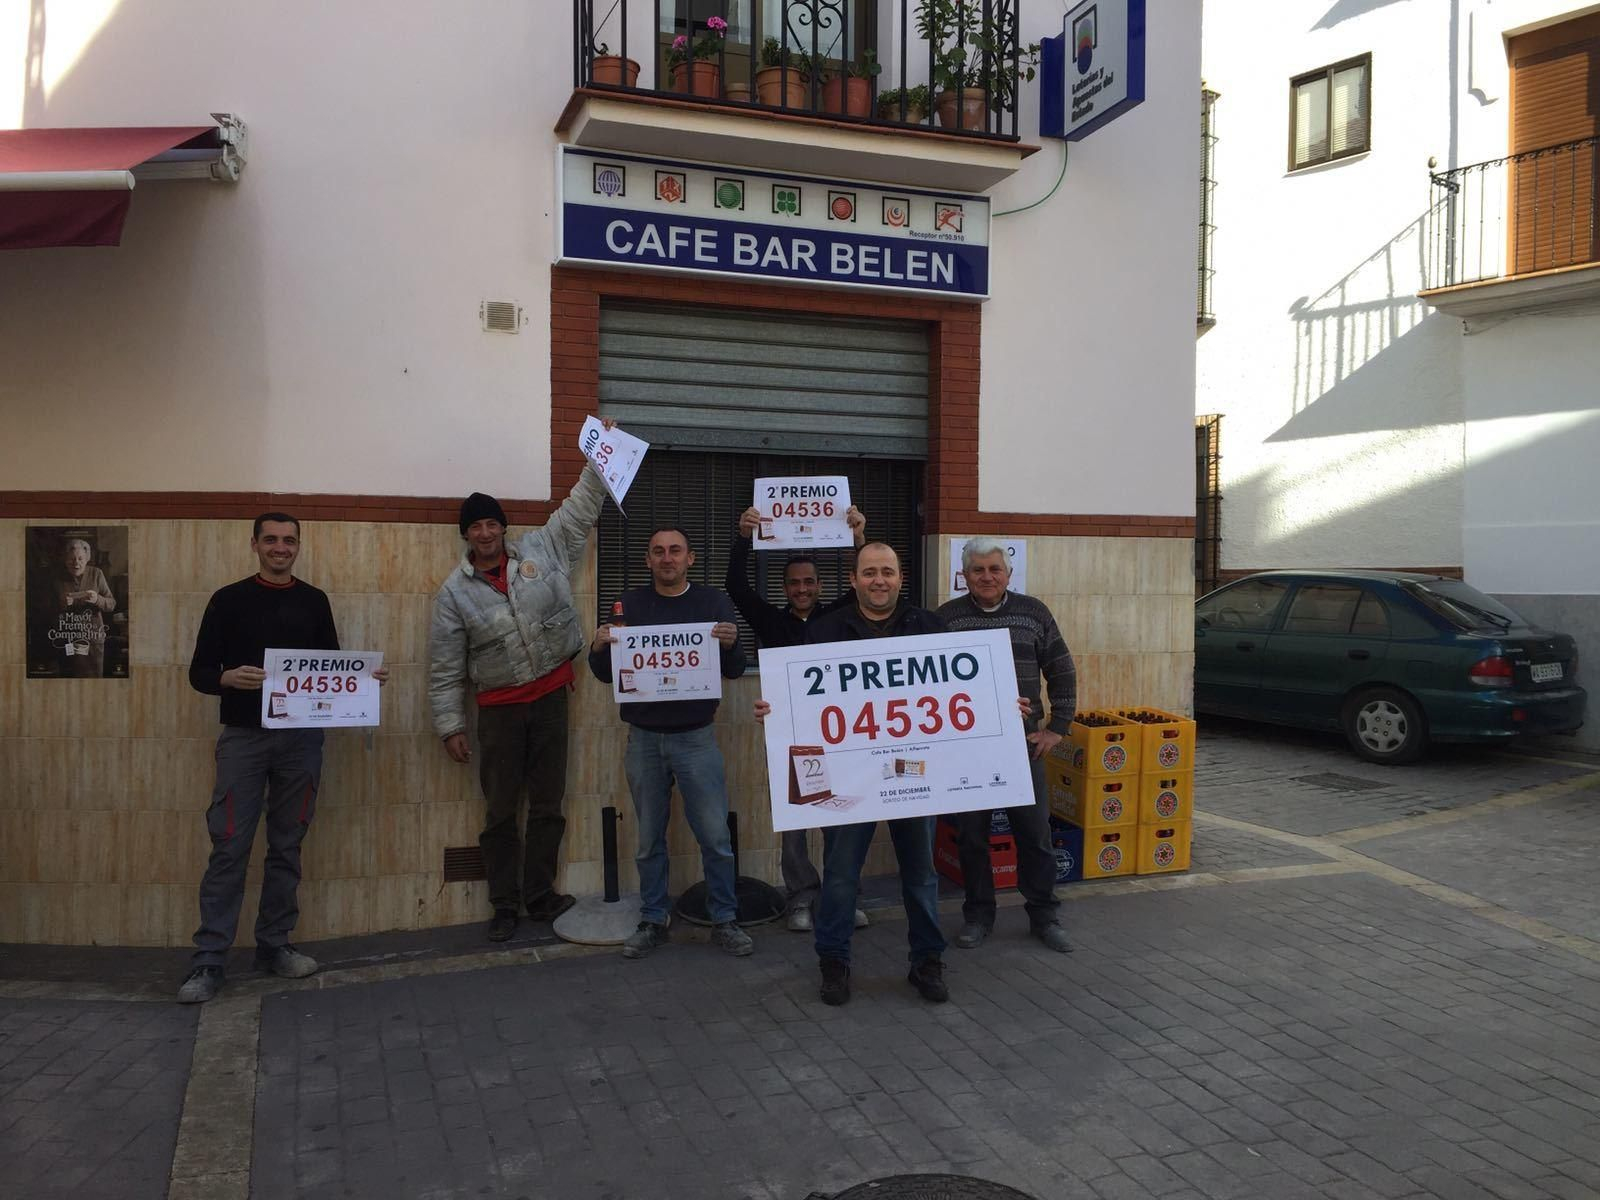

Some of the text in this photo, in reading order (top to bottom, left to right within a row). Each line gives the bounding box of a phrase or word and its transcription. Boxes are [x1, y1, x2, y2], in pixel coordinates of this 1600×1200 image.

[909, 229, 937, 241] Receptor
[605, 219, 955, 284] CAFE BAR BELEN
[781, 485, 838, 498] PREMIO
[772, 501, 834, 518] 04536
[65, 609, 92, 623] Mayor
[59, 619, 93, 632] Premio
[642, 632, 704, 649] PREMIO
[298, 659, 365, 672] PREMIO
[633, 650, 700, 670] 04536
[838, 652, 979, 693] PREMIO
[286, 675, 358, 693] 04536
[820, 692, 976, 745] 04536
[803, 759, 824, 778] 22
[898, 786, 931, 795] DICIEMBRE
